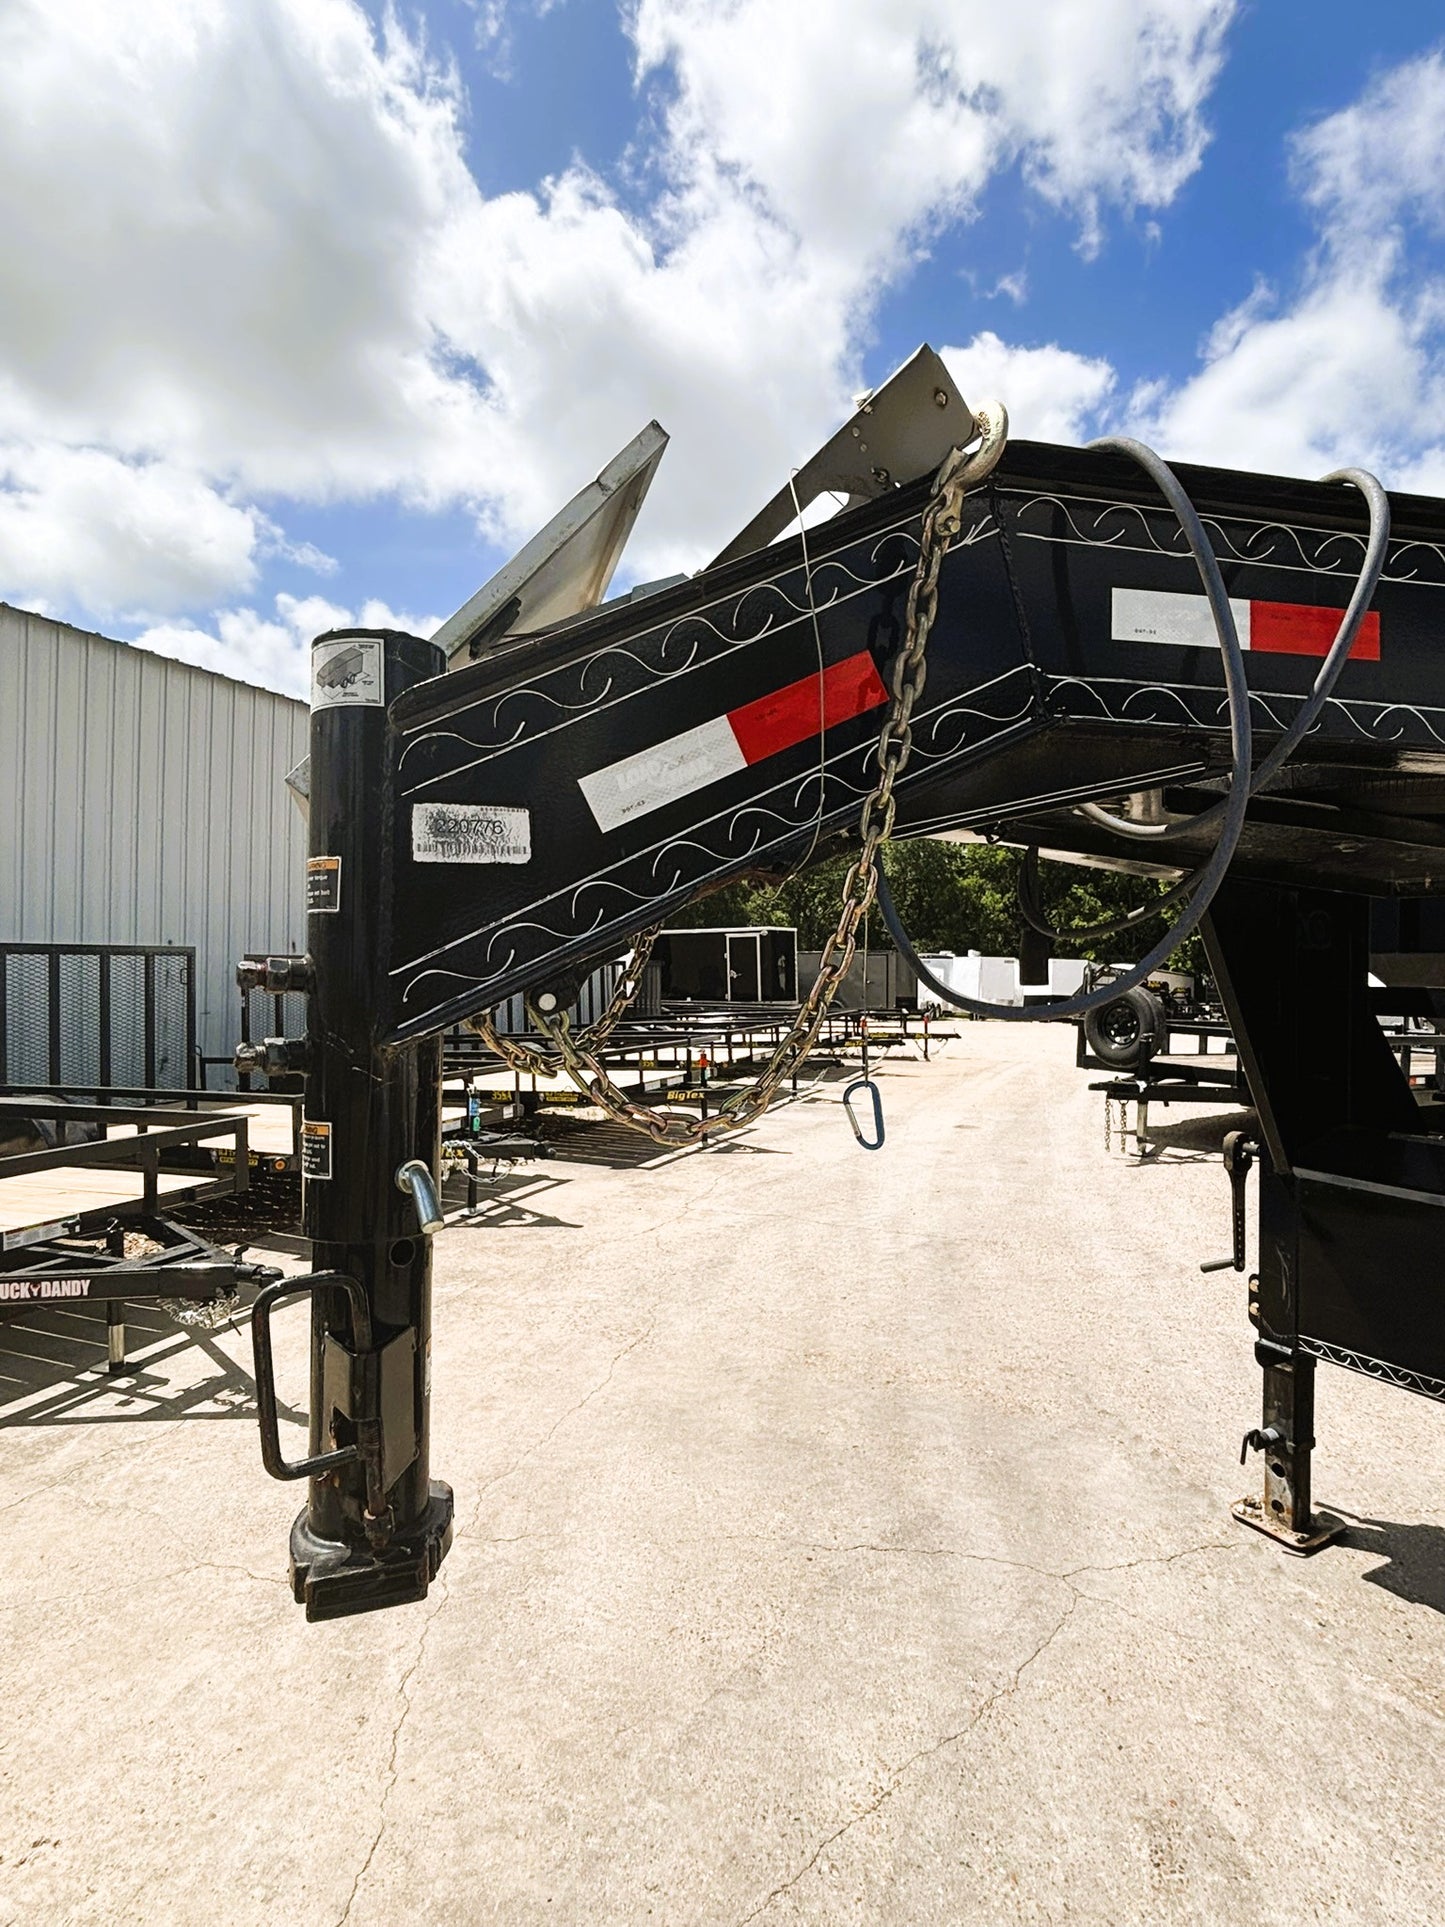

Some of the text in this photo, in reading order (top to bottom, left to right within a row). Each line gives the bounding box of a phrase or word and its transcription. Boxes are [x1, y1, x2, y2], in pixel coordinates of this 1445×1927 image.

[437, 819, 504, 835] 220776
[0, 1280, 91, 1299] UCK DANDY
